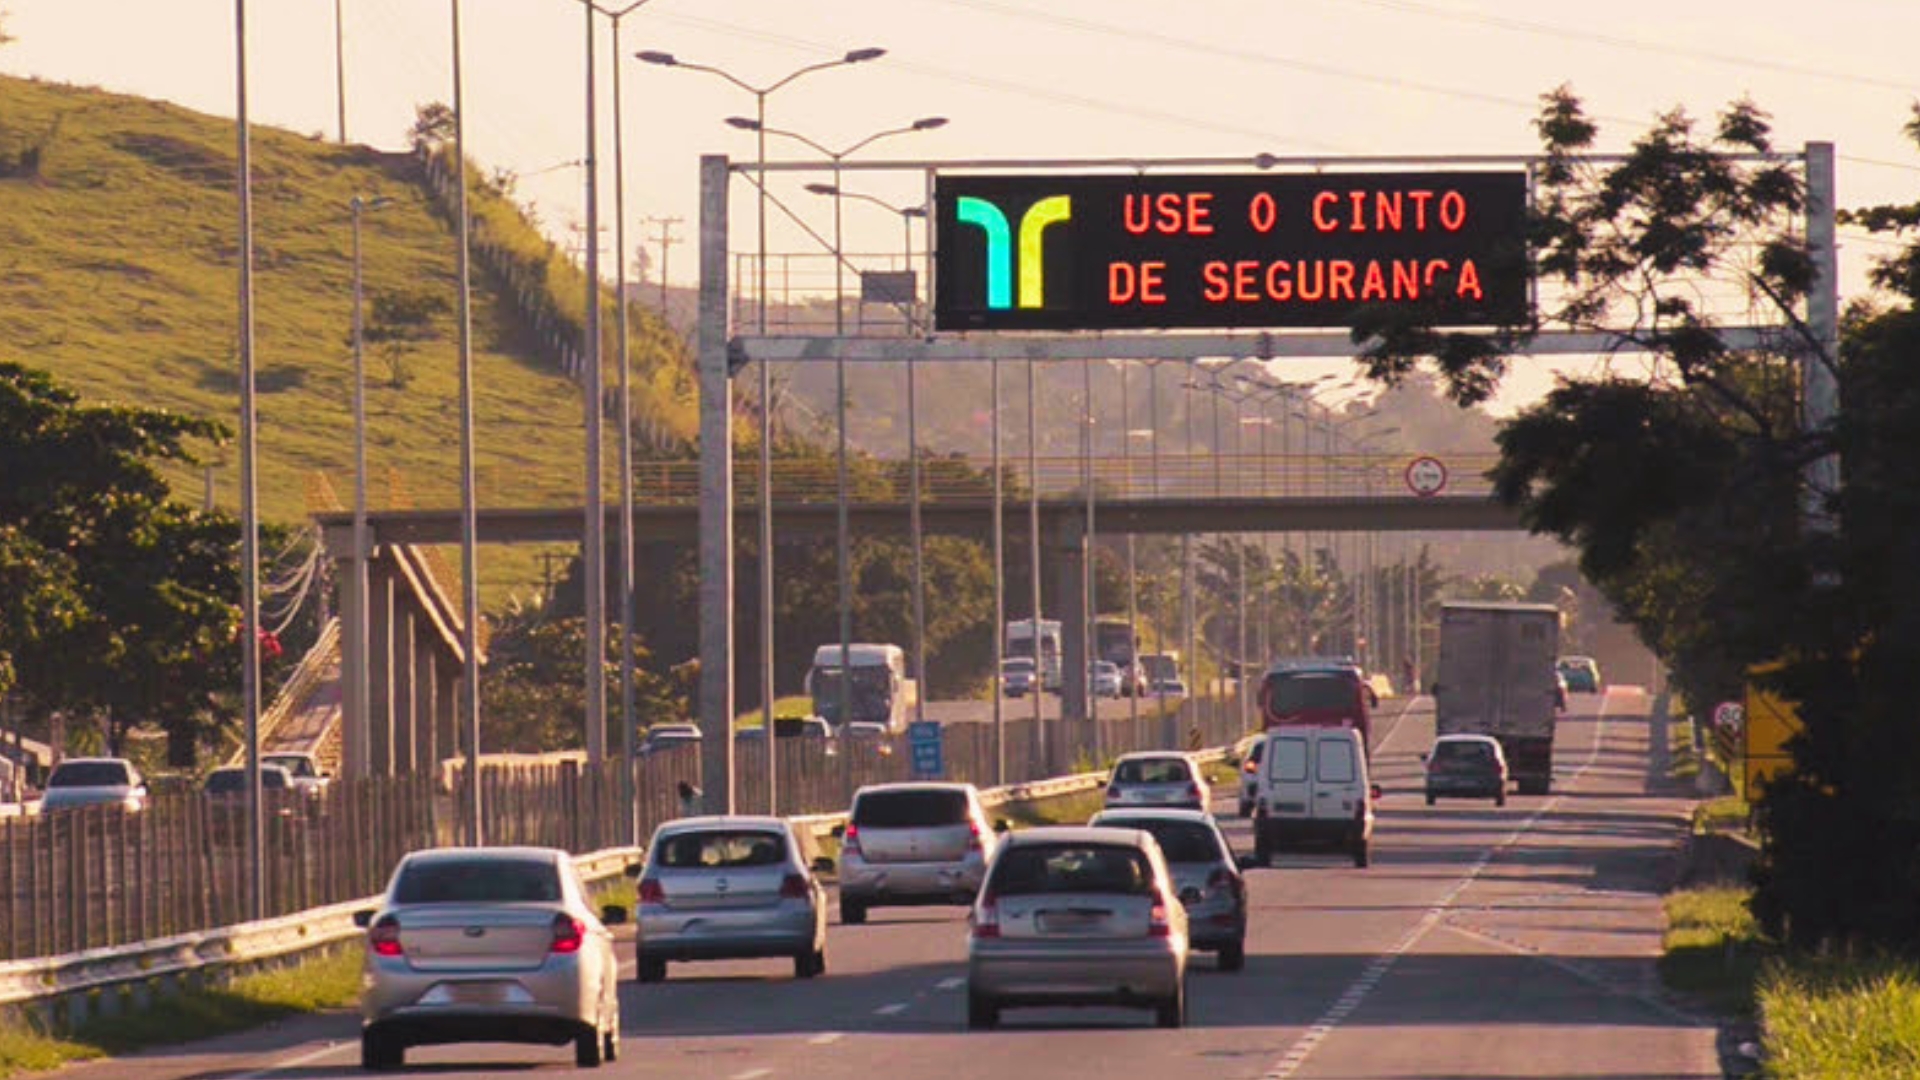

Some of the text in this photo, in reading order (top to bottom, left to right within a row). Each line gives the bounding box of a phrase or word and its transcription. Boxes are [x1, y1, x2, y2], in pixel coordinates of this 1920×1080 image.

[1123, 189, 1466, 235] USE O CINTO
[1108, 261, 1167, 304] DE
